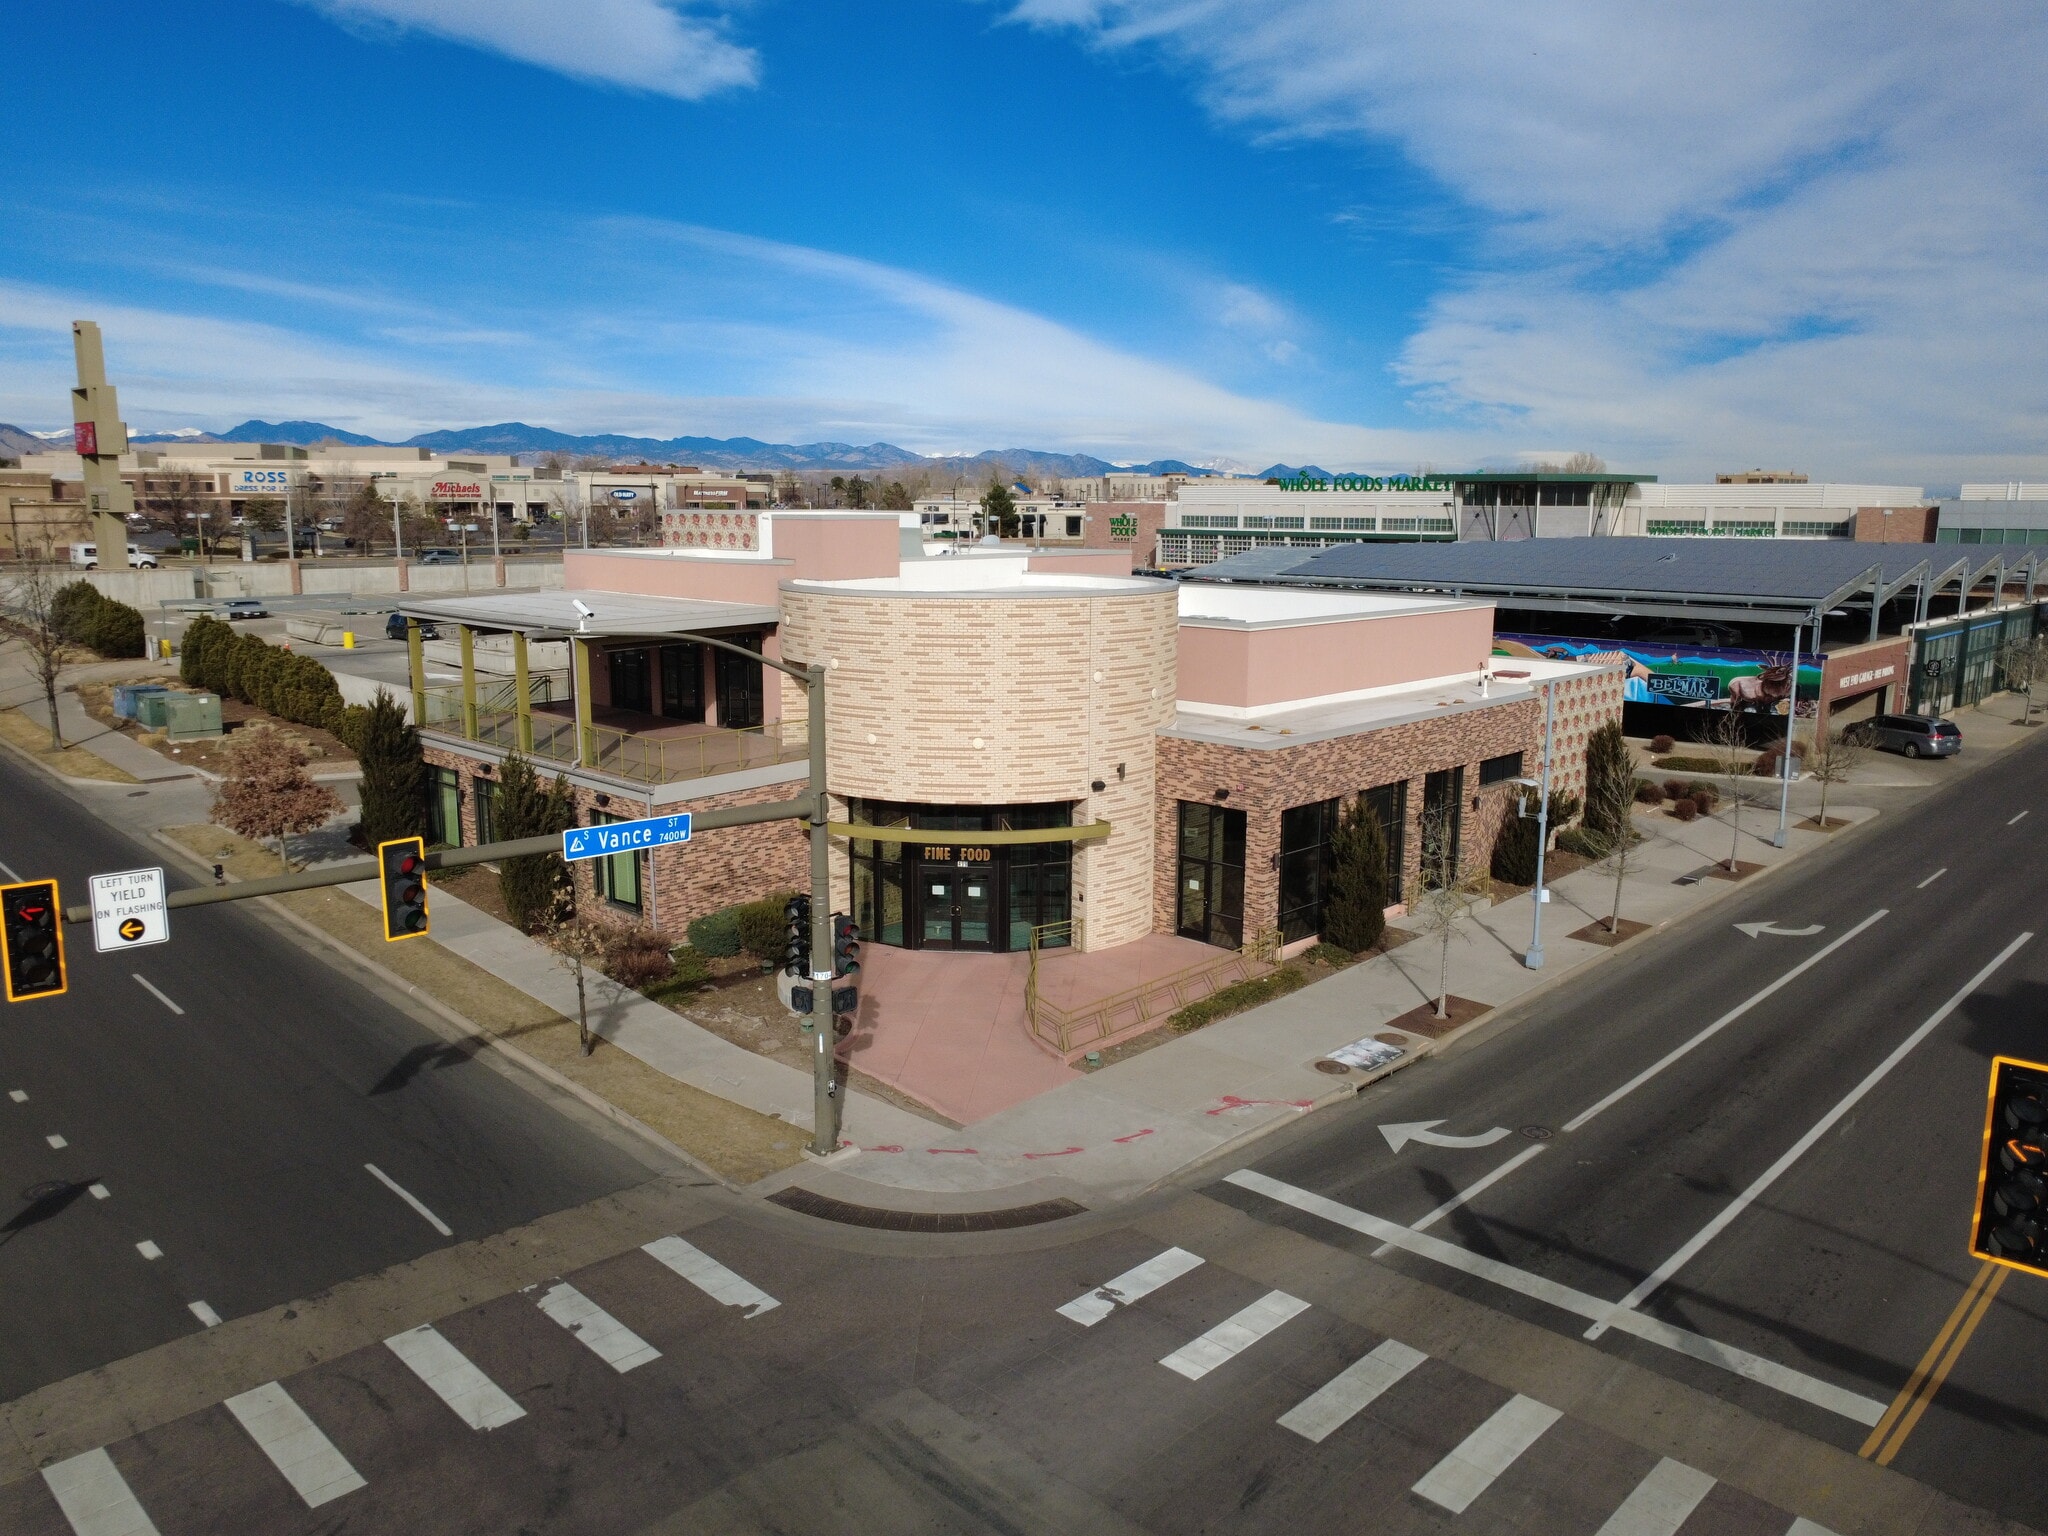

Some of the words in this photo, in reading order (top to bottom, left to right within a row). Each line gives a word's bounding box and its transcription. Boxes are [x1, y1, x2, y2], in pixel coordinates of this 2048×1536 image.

[243, 471, 287, 483] ROSS
[1279, 476, 1328, 492] WHOLE
[1333, 477, 1383, 492] FOODS
[1388, 476, 1451, 492] MARKET
[432, 482, 480, 493] Michaels
[1648, 526, 1685, 536] WHOLE
[1692, 527, 1726, 537] FOODS
[1733, 527, 1777, 538] MARKET
[1650, 677, 1714, 698] BELMAR
[583, 830, 590, 841] S
[598, 827, 652, 850] Vance
[668, 817, 679, 828] ST
[659, 829, 687, 843] 7400W
[924, 846, 951, 861] FINE
[960, 847, 991, 862] FOOD
[100, 877, 123, 889] LEFT
[129, 873, 154, 885] TURN
[111, 887, 146, 902] YIELD
[97, 909, 111, 920] ON
[116, 901, 163, 917] FLASHING
